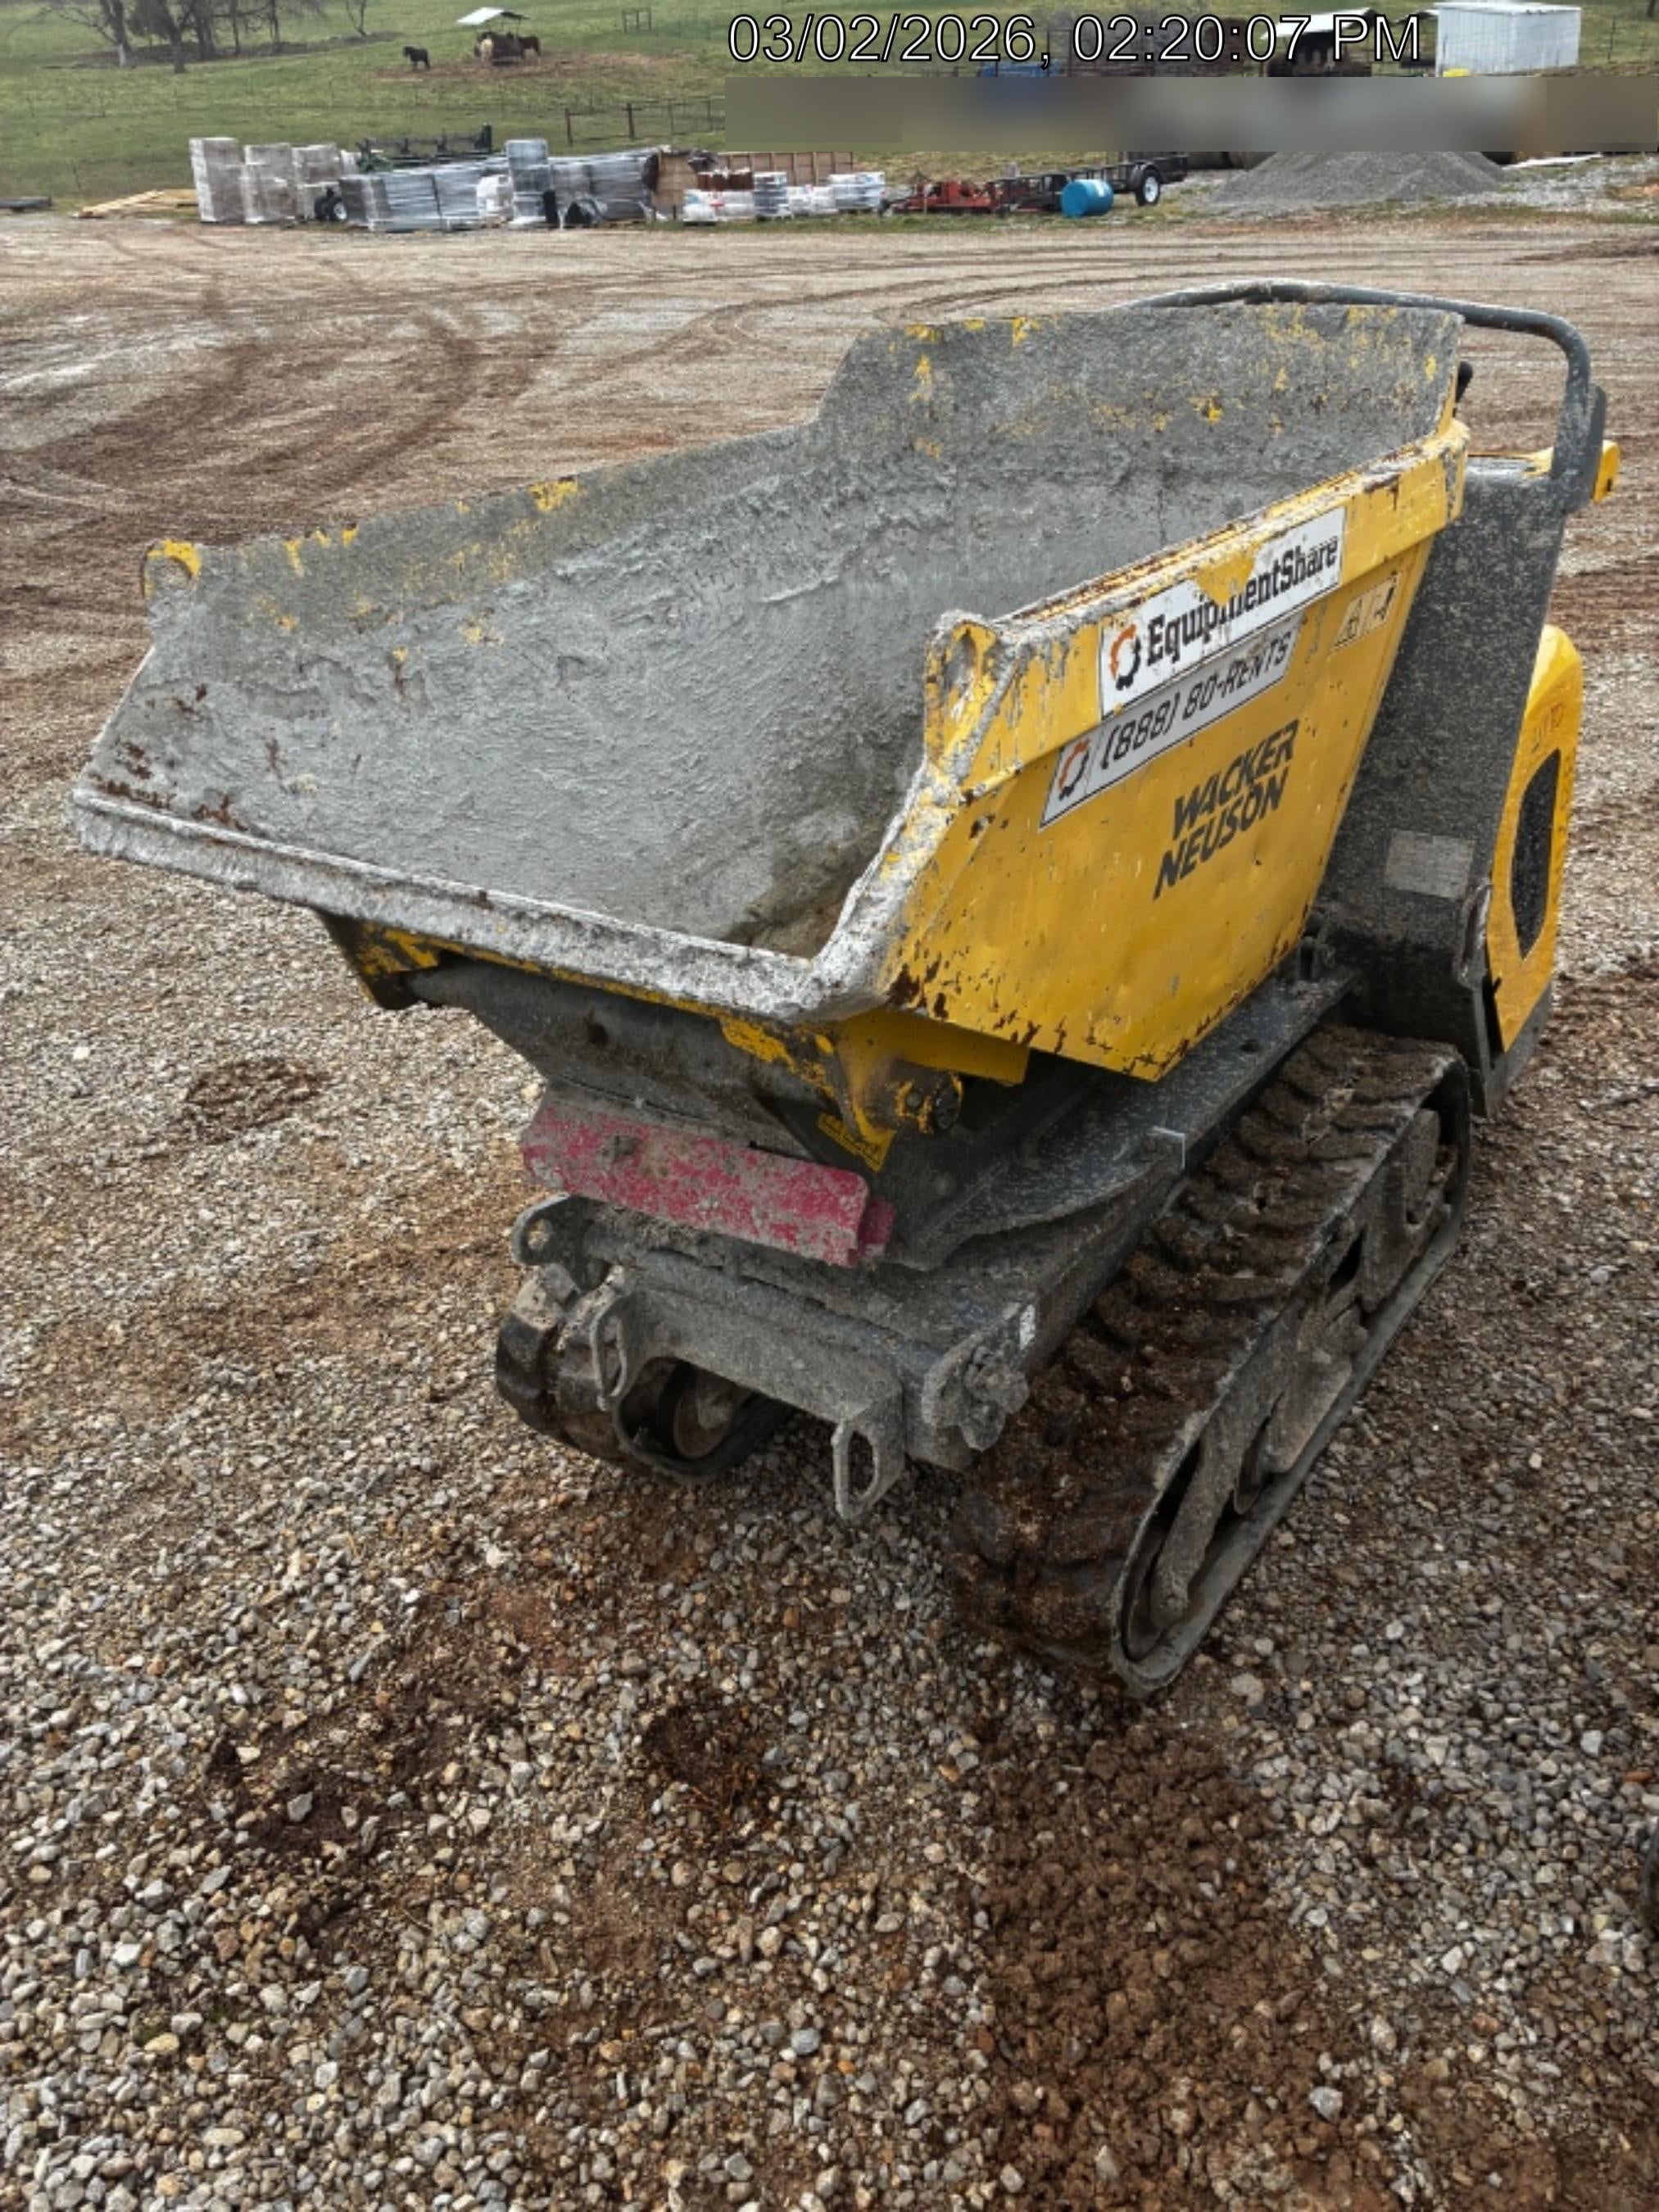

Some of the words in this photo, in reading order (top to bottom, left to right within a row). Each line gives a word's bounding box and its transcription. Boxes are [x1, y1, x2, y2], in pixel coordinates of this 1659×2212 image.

[1100, 691, 1181, 769] (888)
[1182, 630, 1293, 721] 80-RENTS
[1153, 766, 1290, 900] NEUSON
[1172, 718, 1299, 841] WACKER
